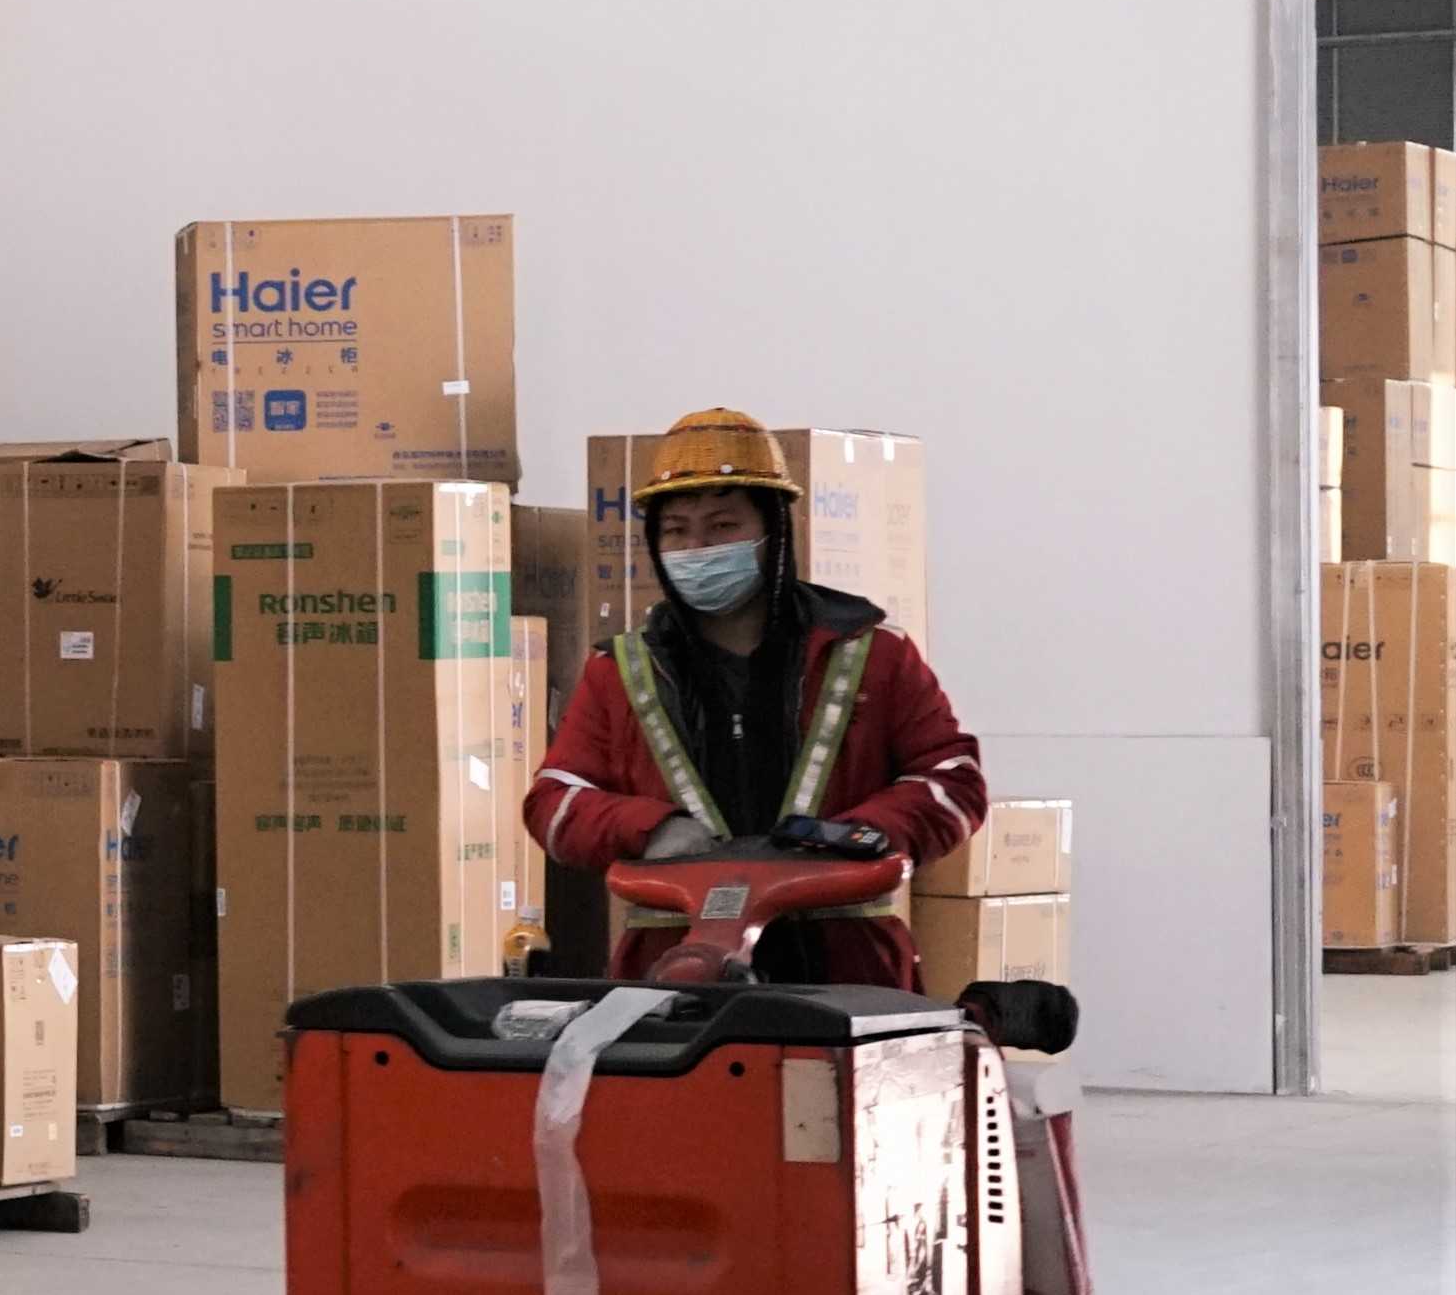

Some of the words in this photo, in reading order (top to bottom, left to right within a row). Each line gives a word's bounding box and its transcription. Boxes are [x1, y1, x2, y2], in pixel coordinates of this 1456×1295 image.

[210, 268, 358, 313] Haier
[213, 318, 283, 338] smart
[288, 318, 358, 337] home
[814, 482, 860, 521] Haier
[259, 589, 397, 614] Ronshen
[276, 621, 379, 646] 容声冰箱
[1321, 633, 1383, 661] aier
